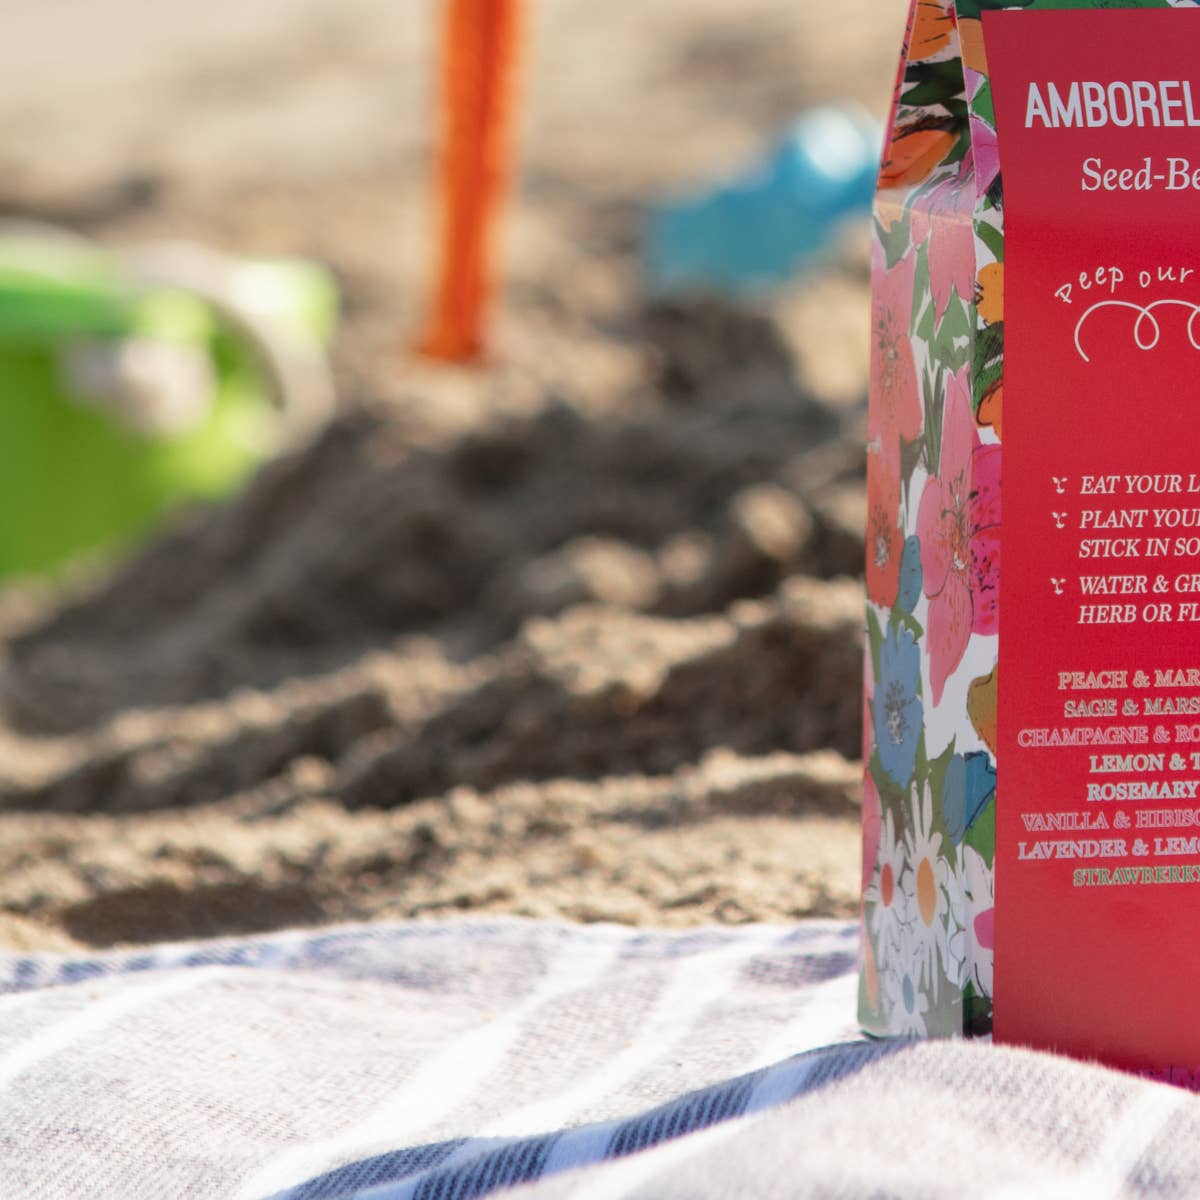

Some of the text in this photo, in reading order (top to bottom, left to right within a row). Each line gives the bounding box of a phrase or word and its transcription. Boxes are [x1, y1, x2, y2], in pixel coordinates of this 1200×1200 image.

[1139, 267, 1193, 288] our
[1080, 476, 1120, 494] EAT
[1125, 475, 1182, 493] YOUR
[1080, 509, 1149, 528] PLANT
[1079, 539, 1141, 558] STICK
[1145, 538, 1170, 556] IN
[1080, 575, 1147, 594] WATER
[1152, 575, 1169, 593] &
[1078, 604, 1136, 624] HERB
[1142, 604, 1172, 622] OR
[1058, 670, 1128, 690] PEACH
[1132, 670, 1150, 688] &
[1064, 699, 1117, 718] SAGE
[1122, 699, 1139, 716] &
[1017, 726, 1149, 747] CHAMPAGNE
[1153, 725, 1171, 743] &
[1089, 753, 1165, 773] LEMON
[1169, 753, 1187, 771] &
[1087, 780, 1200, 801] ROSEMARY
[1020, 811, 1110, 832] VANILLA
[1113, 810, 1131, 829] &
[1018, 839, 1128, 860] LAVENDER
[1132, 838, 1149, 856] &
